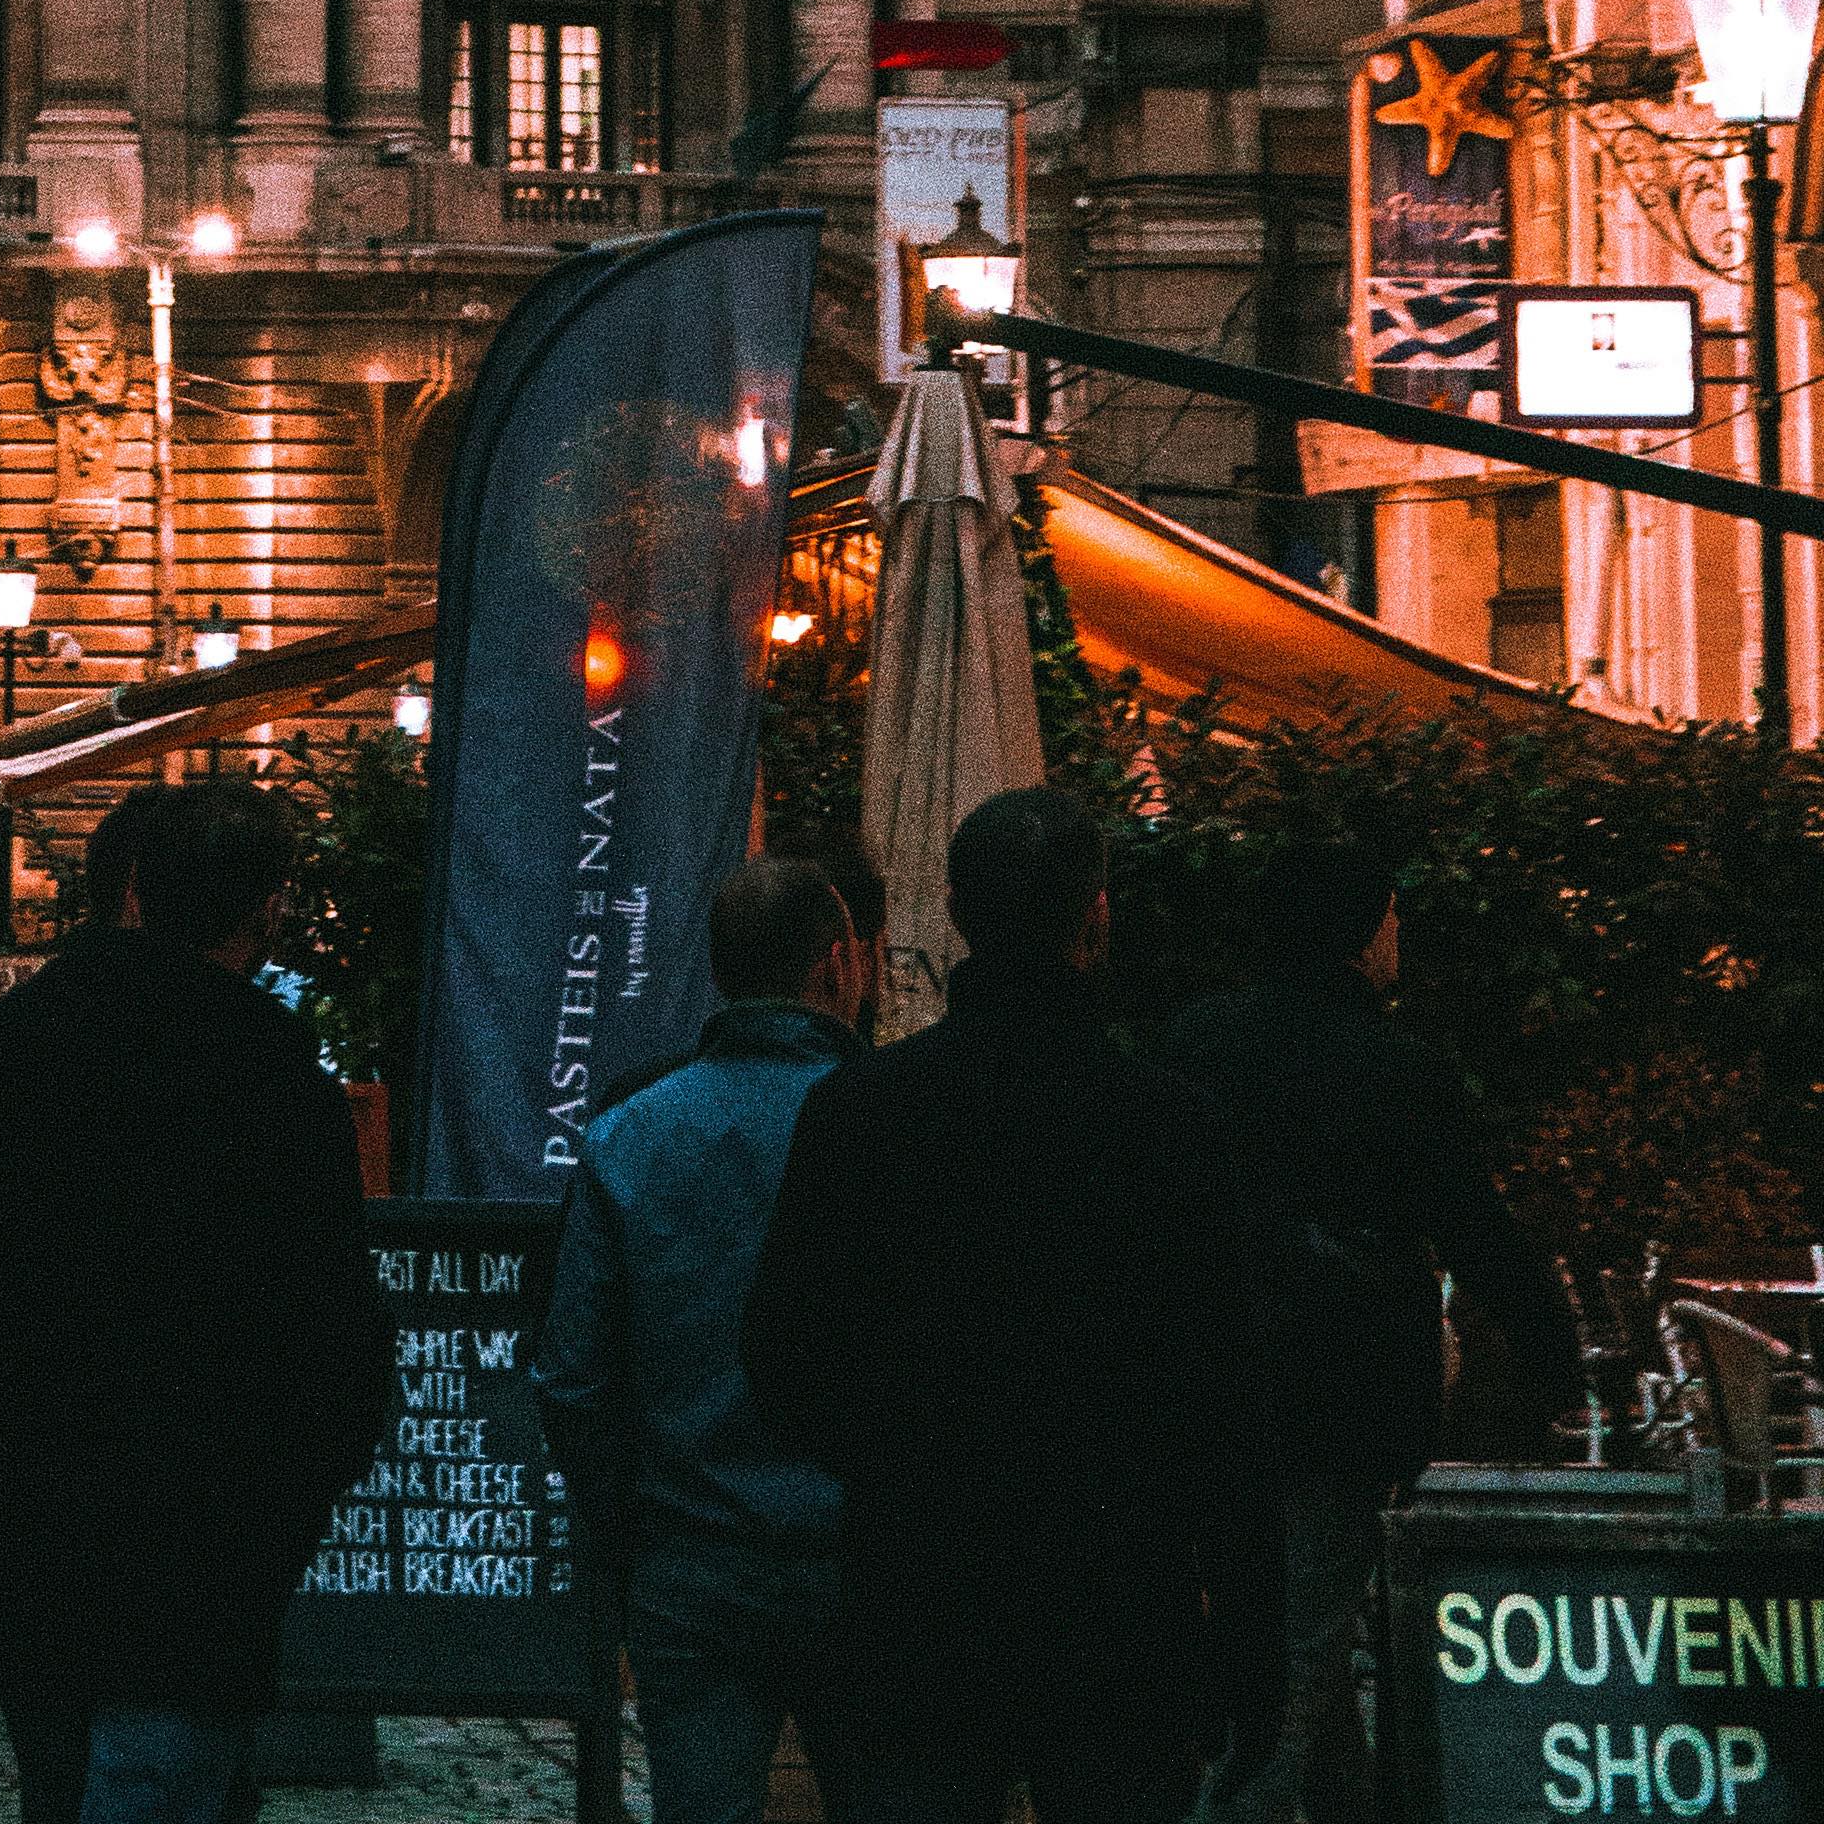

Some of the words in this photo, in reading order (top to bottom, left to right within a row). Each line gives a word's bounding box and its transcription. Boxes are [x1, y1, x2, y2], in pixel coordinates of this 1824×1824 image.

[542, 932, 603, 1169] PASTEIS
[578, 707, 624, 873] NATA
[427, 1251, 470, 1294] ALL
[478, 1252, 526, 1294] DAY
[400, 1371, 467, 1412] WITH
[397, 1416, 490, 1459] CHEESE
[406, 1461, 428, 1498] &
[434, 1461, 527, 1506] CHEESE
[402, 1507, 538, 1550] BREAKFAST
[404, 1551, 540, 1597] BREAKFAST
[1541, 1721, 1769, 1818] SHOP
